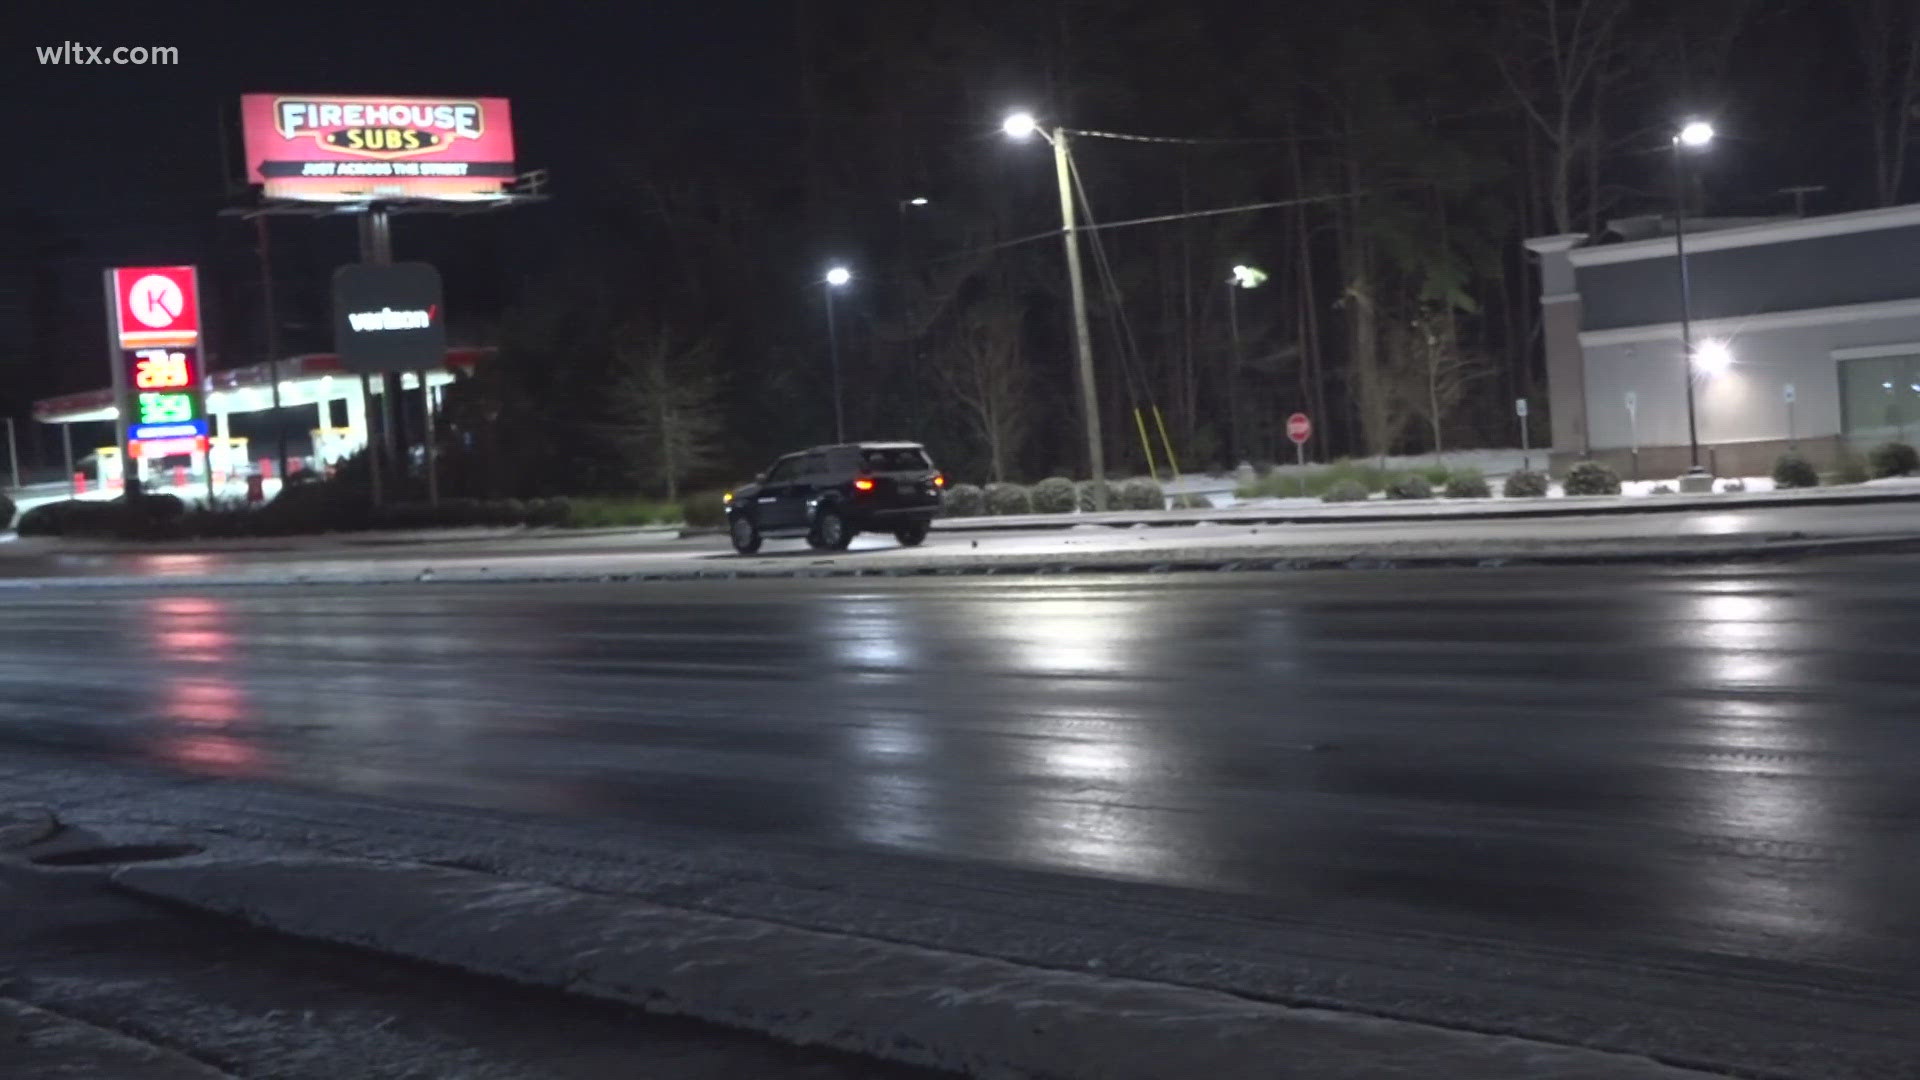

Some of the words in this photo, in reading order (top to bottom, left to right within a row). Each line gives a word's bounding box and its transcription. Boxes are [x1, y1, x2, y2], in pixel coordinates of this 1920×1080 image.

[281, 103, 480, 140] FIREHOUSE
[346, 128, 421, 150] SUBS
[302, 163, 336, 176] JUST
[337, 163, 392, 176] ACROSS
[393, 163, 419, 176] THE
[420, 163, 468, 176] STREET
[348, 307, 430, 332] verizon
